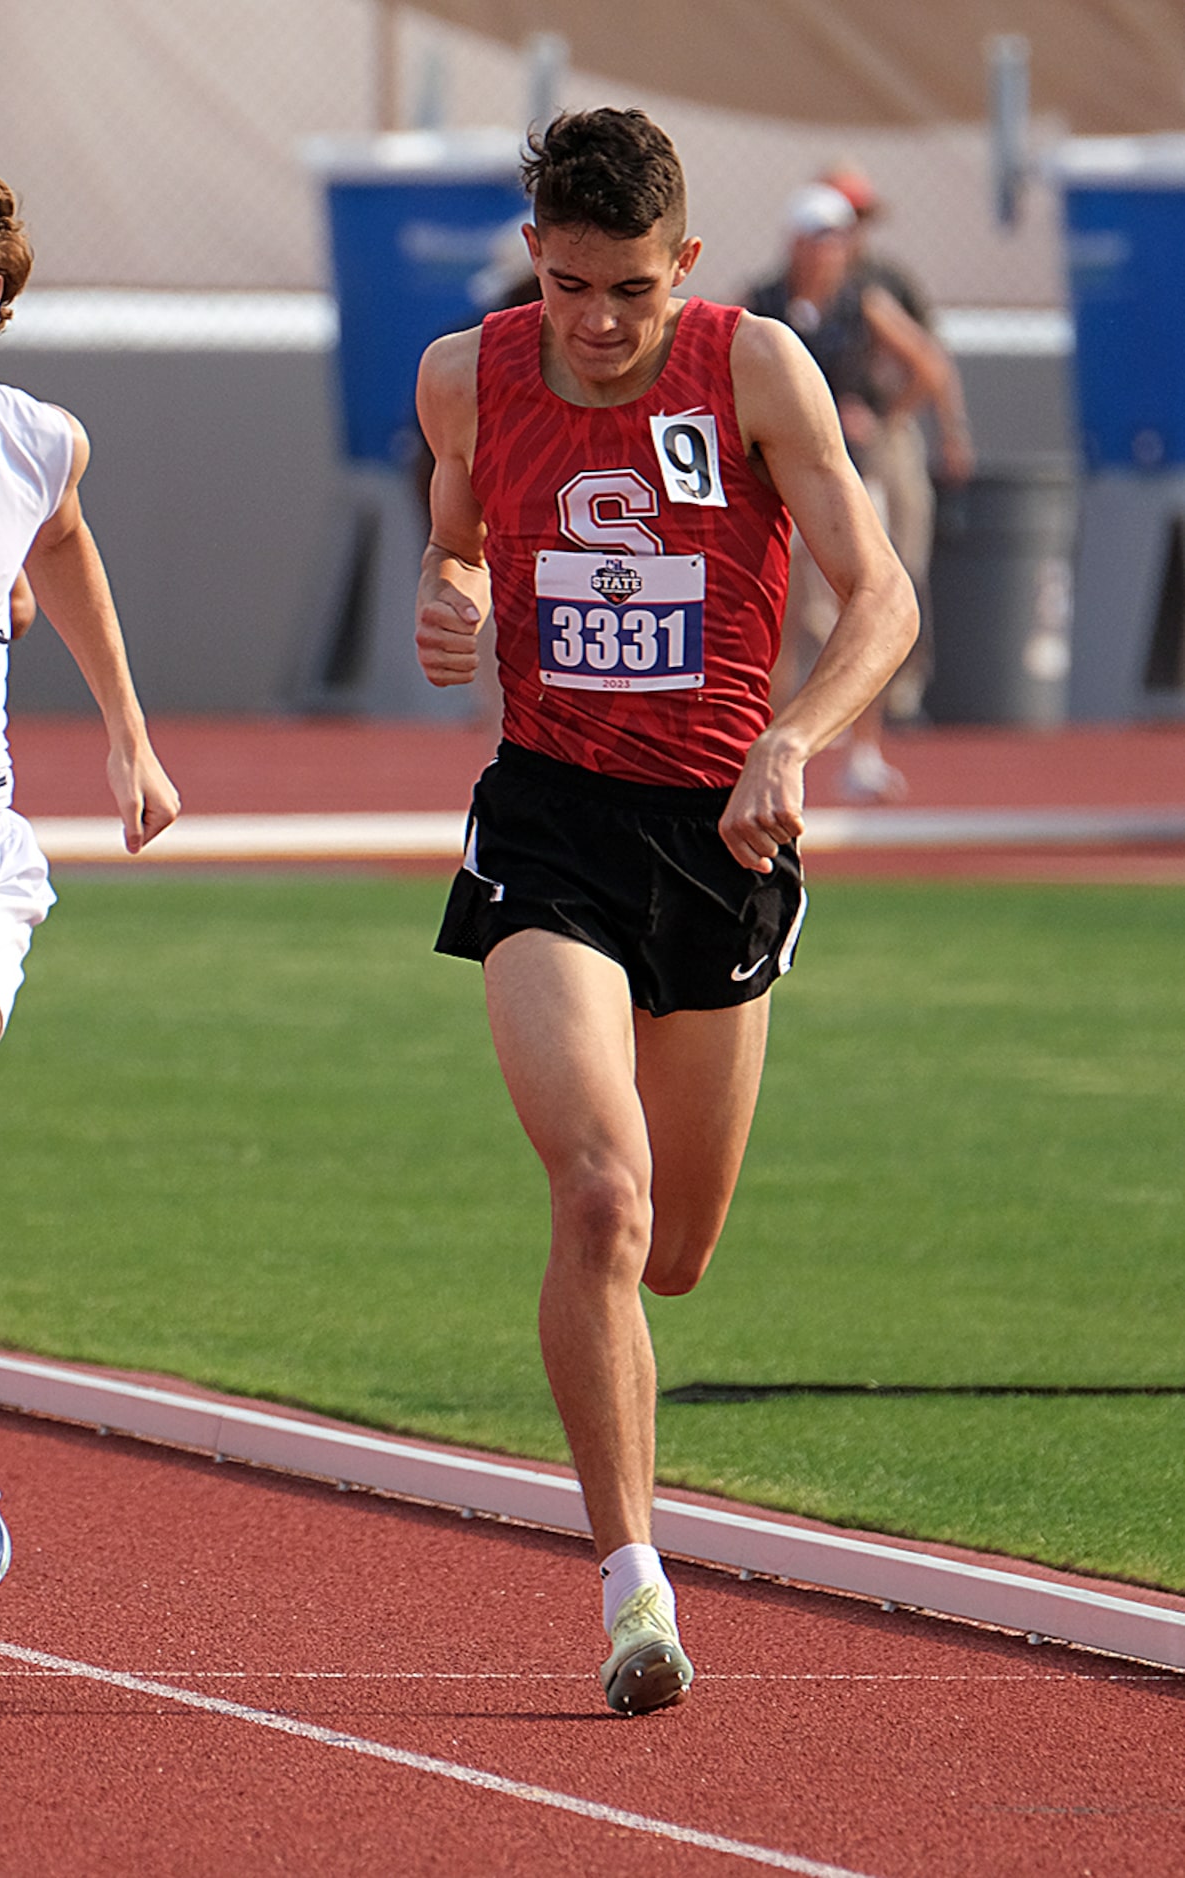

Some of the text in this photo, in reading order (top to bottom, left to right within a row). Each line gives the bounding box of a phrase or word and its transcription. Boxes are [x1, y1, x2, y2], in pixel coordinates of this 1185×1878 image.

[663, 423, 712, 500] 9
[556, 468, 664, 556] S
[592, 576, 641, 590] STATE
[551, 605, 686, 671] 3331
[602, 679, 631, 689] 2023
